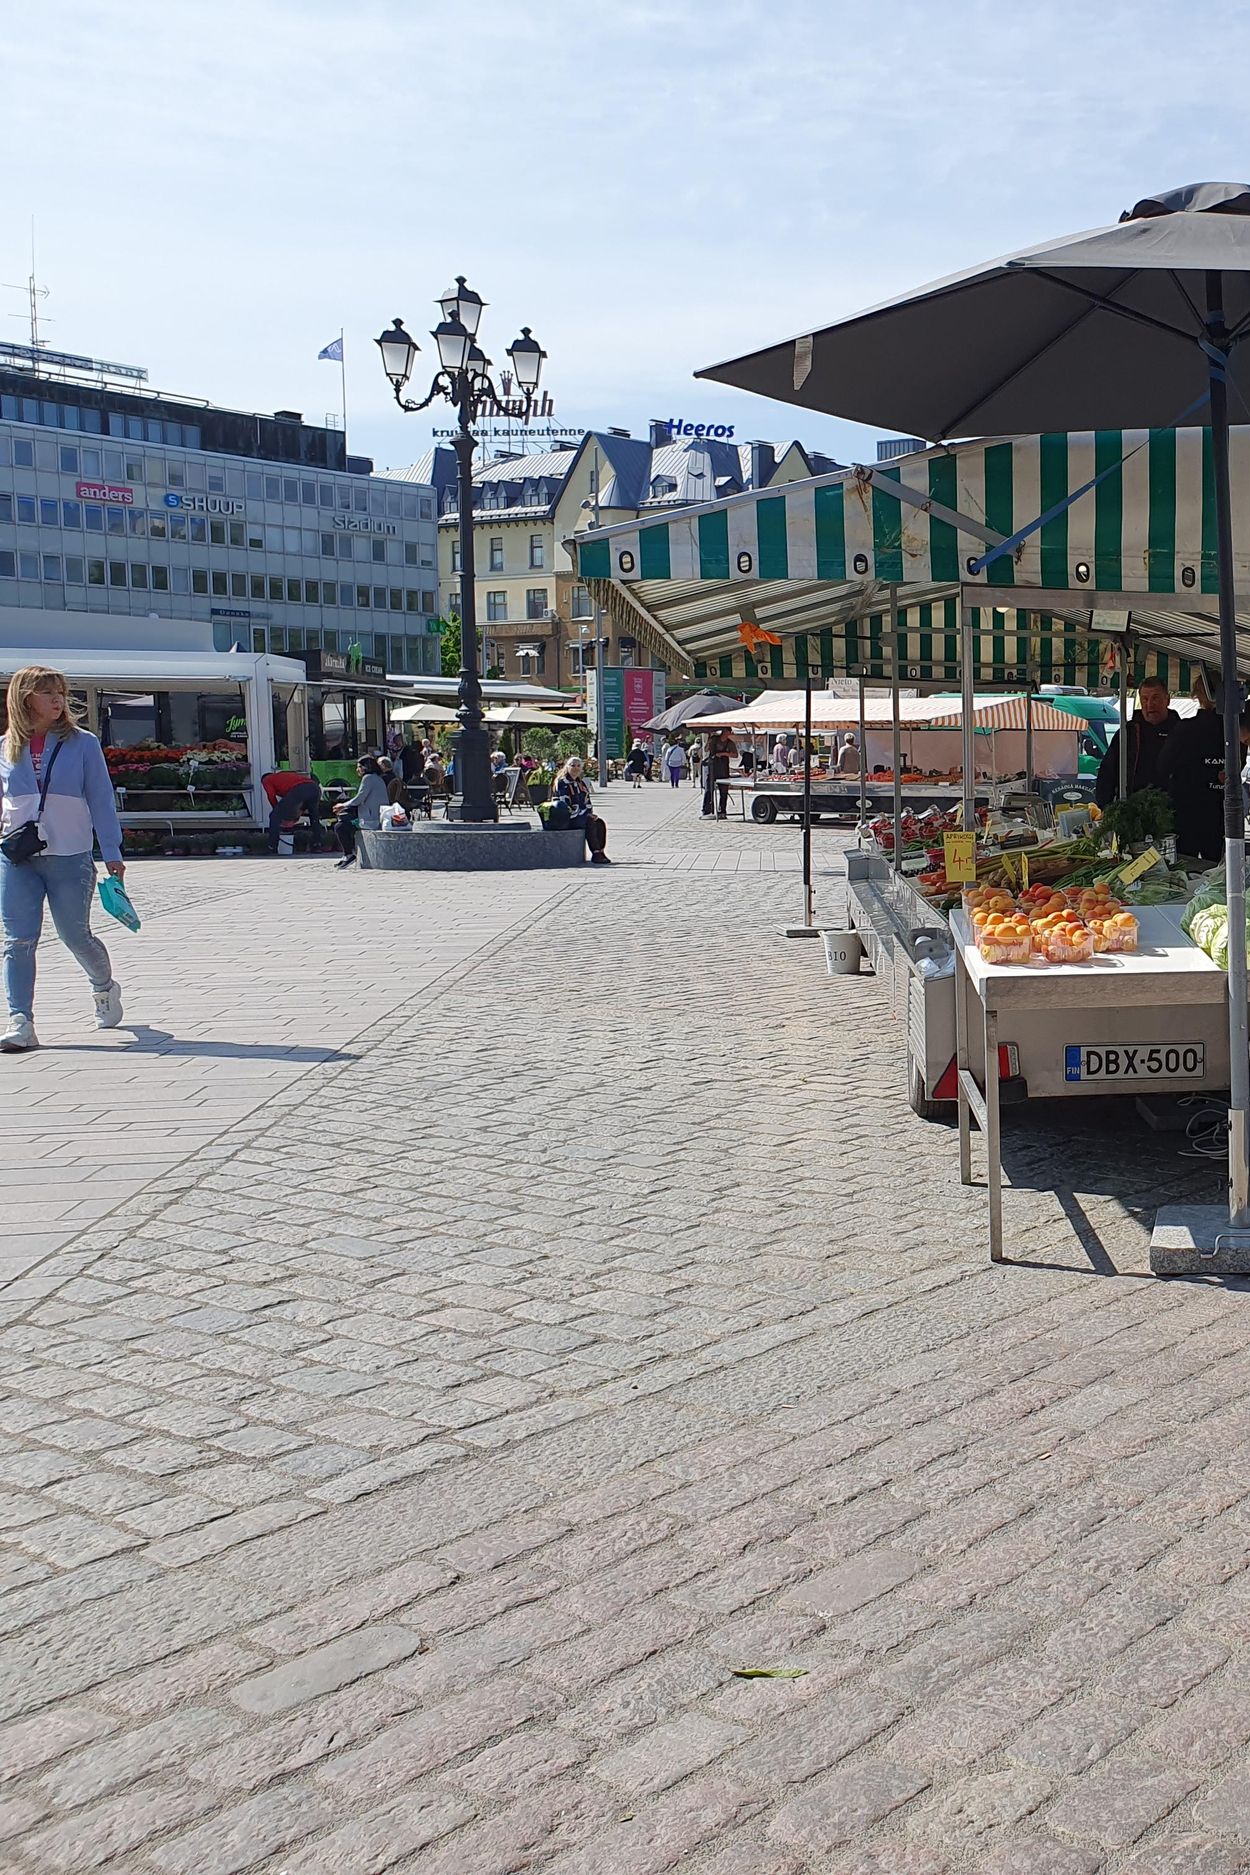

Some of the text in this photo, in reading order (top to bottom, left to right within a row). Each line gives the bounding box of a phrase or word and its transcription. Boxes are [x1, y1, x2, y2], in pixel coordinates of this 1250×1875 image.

[666, 418, 735, 438] Heeros
[80, 486, 133, 502] anders
[181, 495, 245, 515] SHUUP
[333, 514, 397, 535] stadium
[1067, 1048, 1197, 1075] FIN DBX-500
